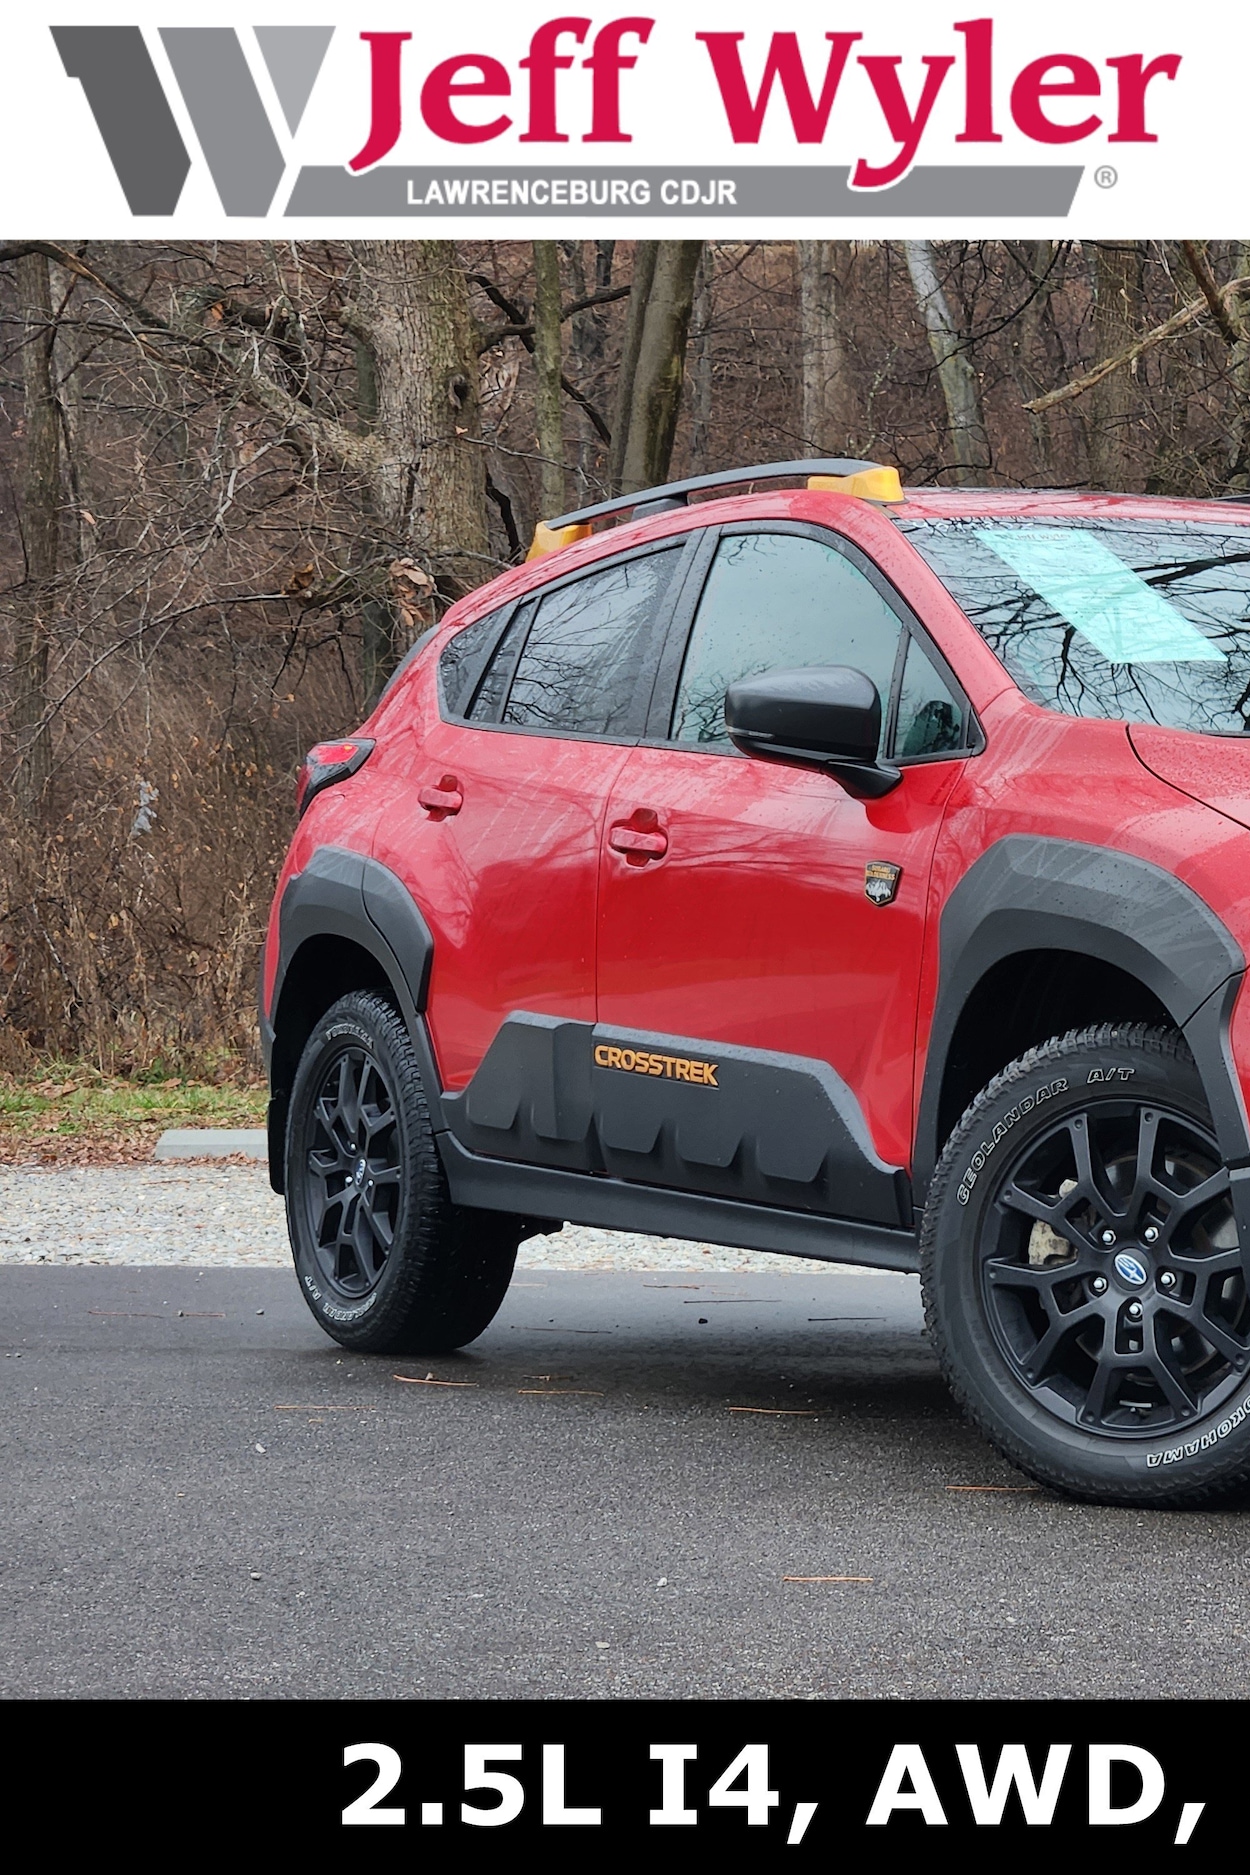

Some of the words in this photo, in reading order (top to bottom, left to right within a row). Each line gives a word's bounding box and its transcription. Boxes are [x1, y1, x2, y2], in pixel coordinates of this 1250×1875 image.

[593, 1044, 719, 1087] CROSSTREK
[956, 1077, 1069, 1206] GEOLANDAR
[1087, 1066, 1136, 1084] A/T
